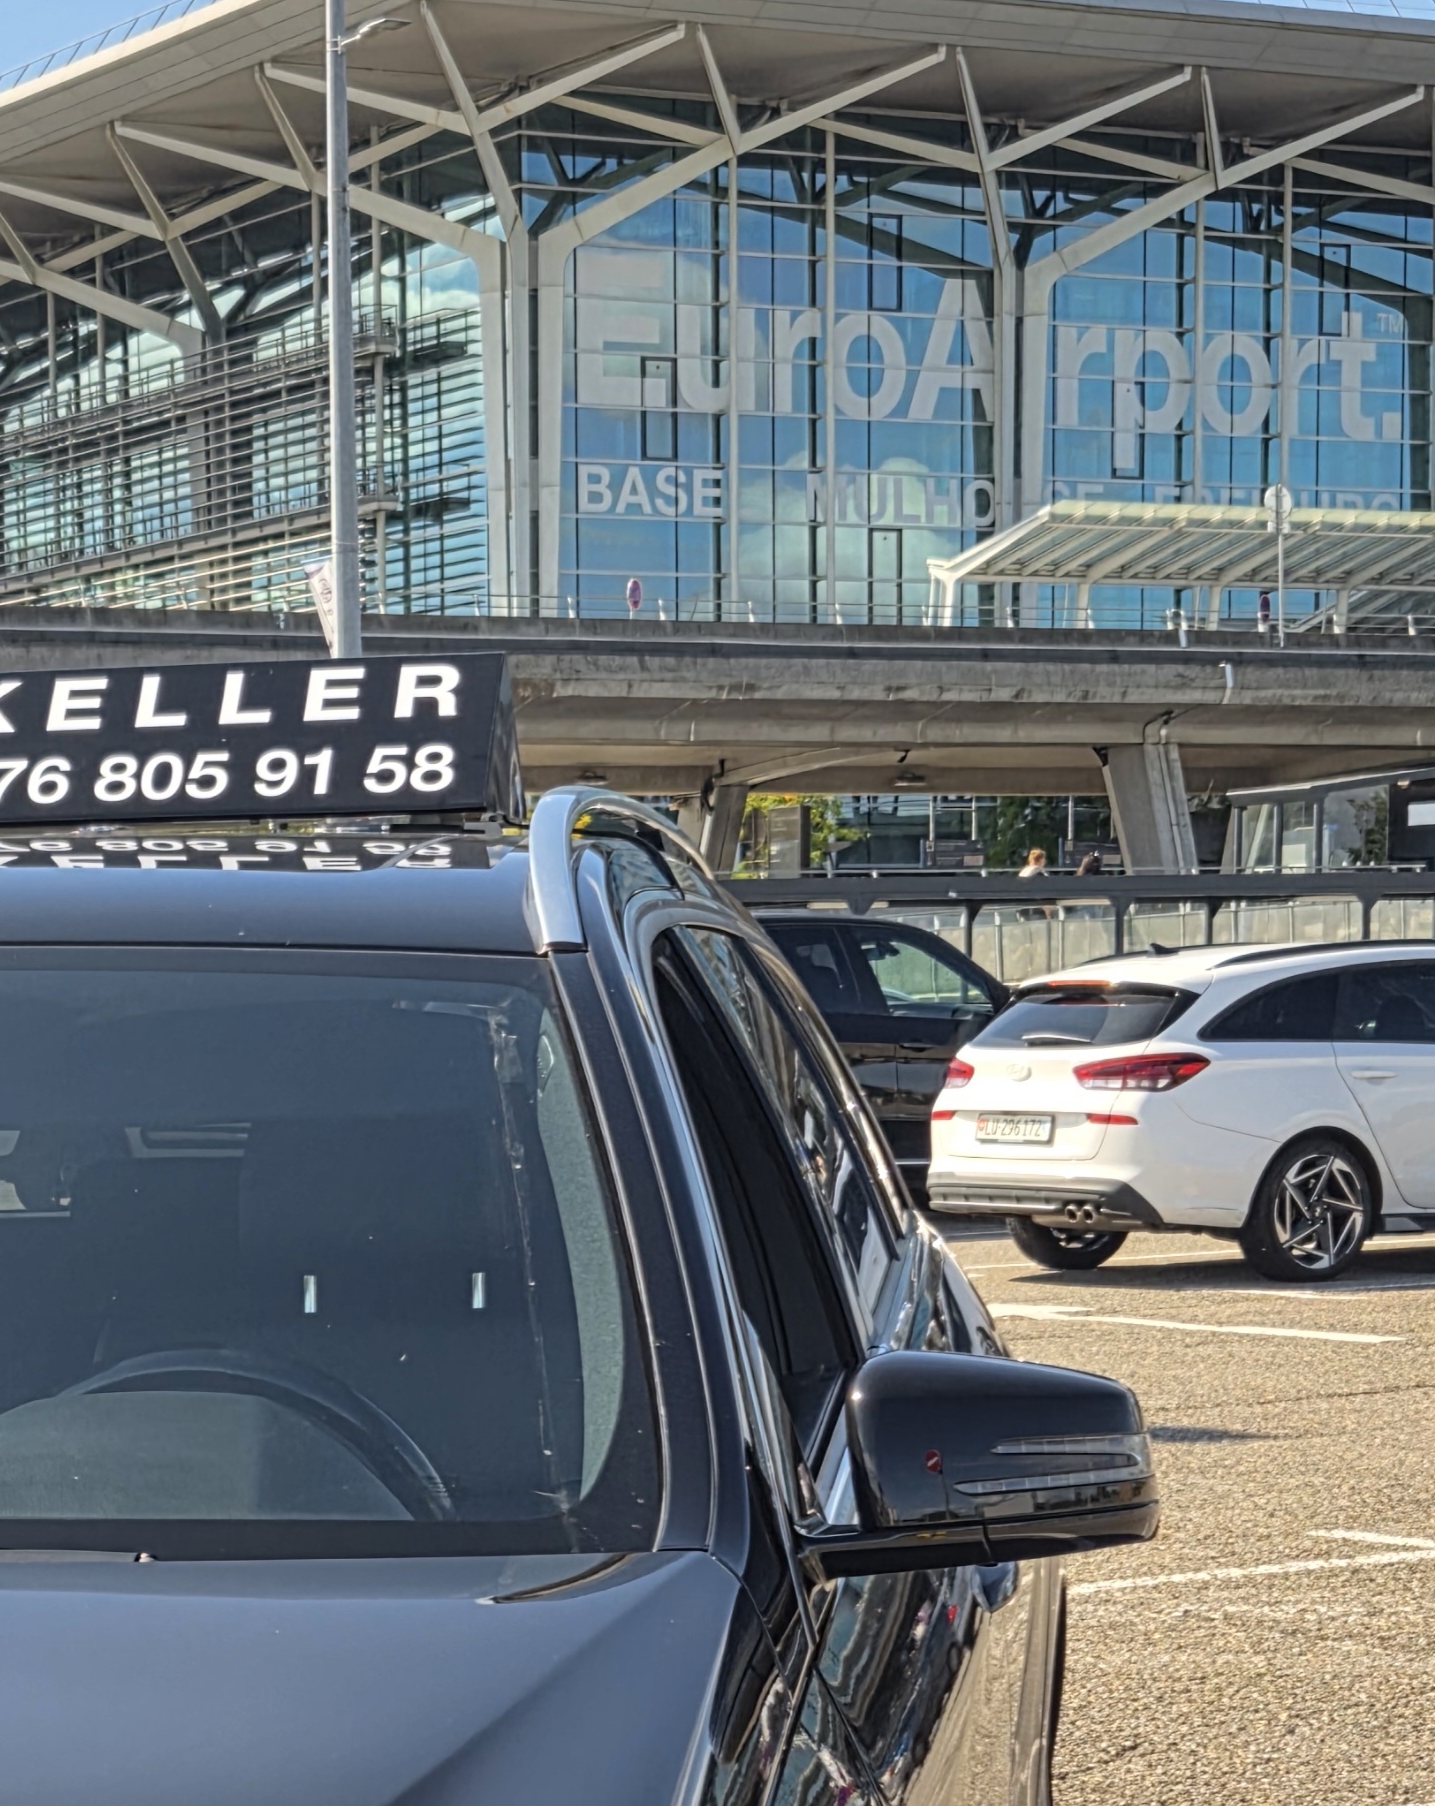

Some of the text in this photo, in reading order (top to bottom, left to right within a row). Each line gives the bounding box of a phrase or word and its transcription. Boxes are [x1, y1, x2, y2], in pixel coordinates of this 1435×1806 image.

[576, 253, 1403, 469] EuroArport.
[93, 749, 230, 802] 805
[254, 746, 334, 797] 91
[363, 742, 457, 795] 58
